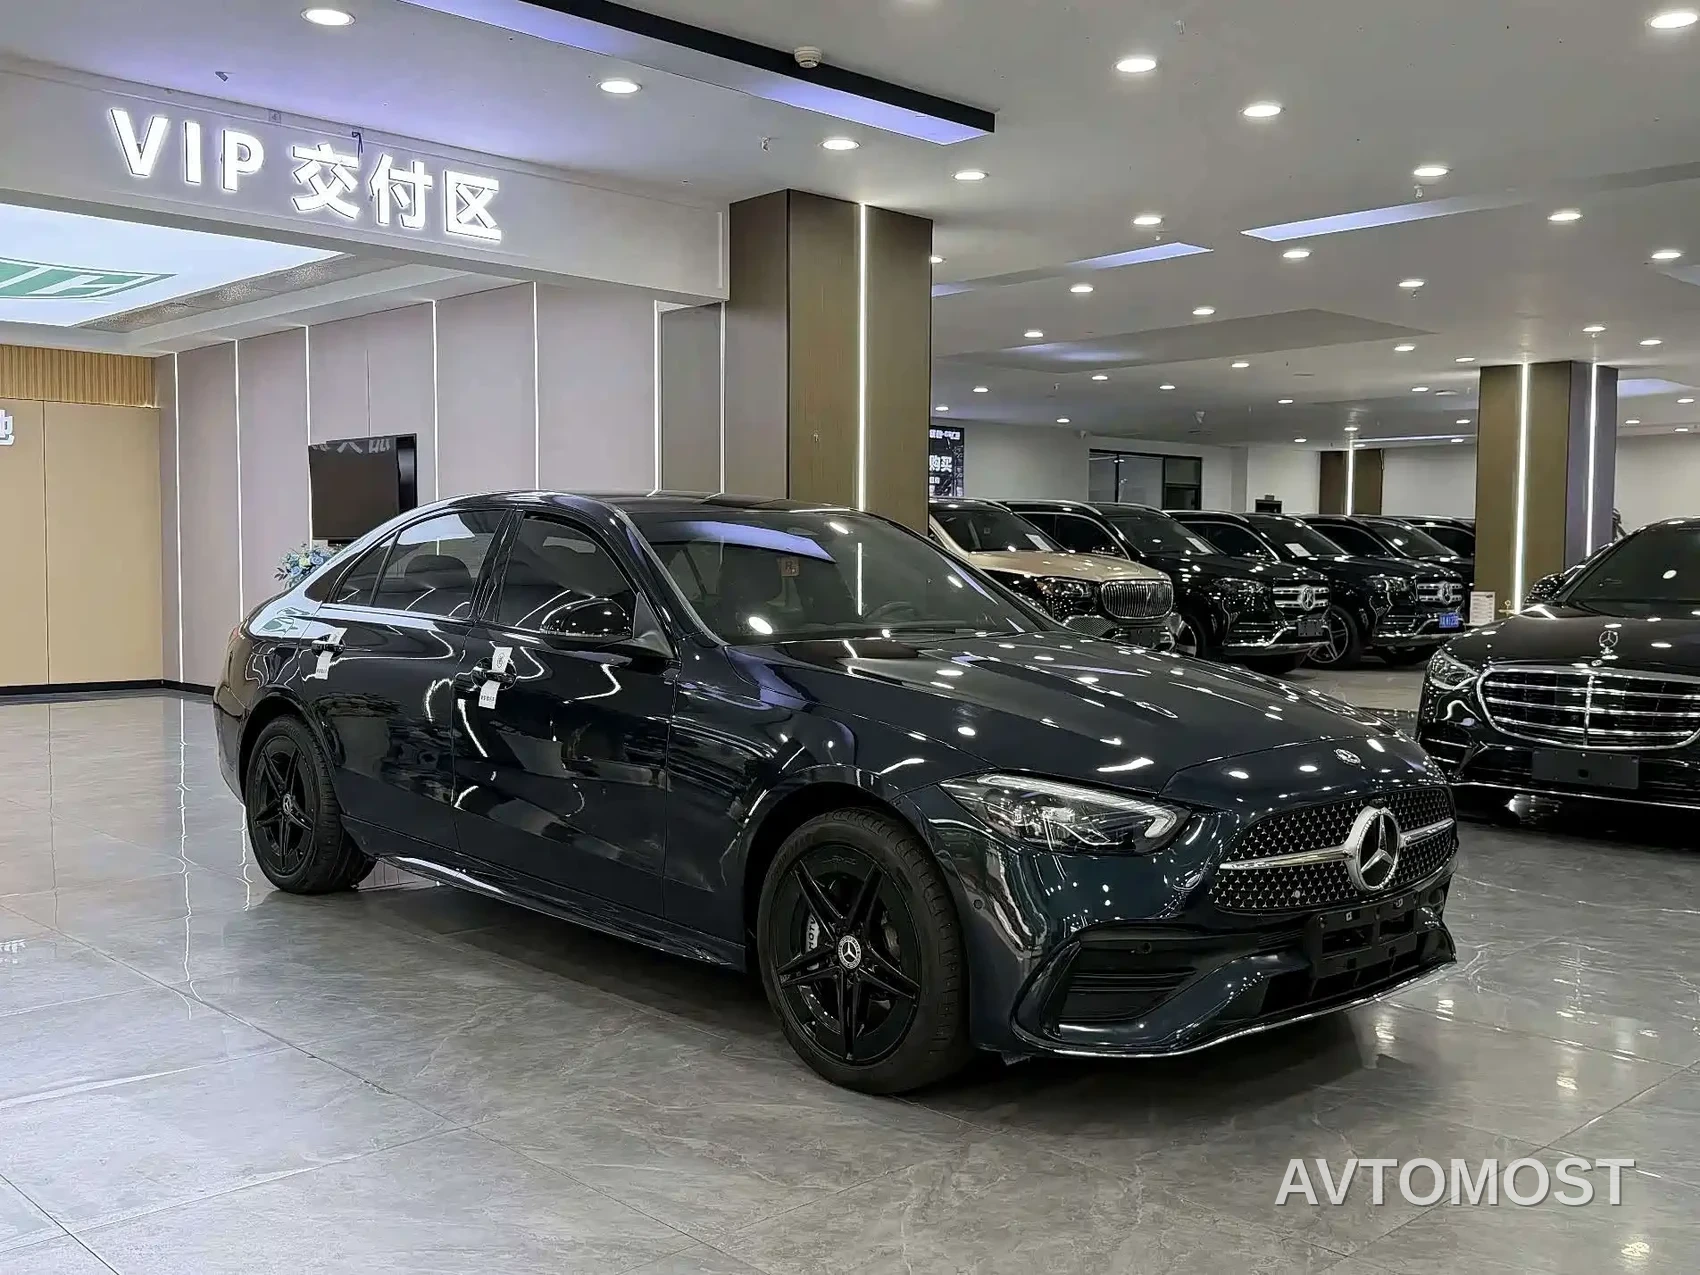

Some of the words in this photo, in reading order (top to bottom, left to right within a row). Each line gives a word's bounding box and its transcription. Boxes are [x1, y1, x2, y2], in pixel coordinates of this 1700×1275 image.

[110, 108, 264, 191] VIP
[292, 143, 501, 241] 交付区
